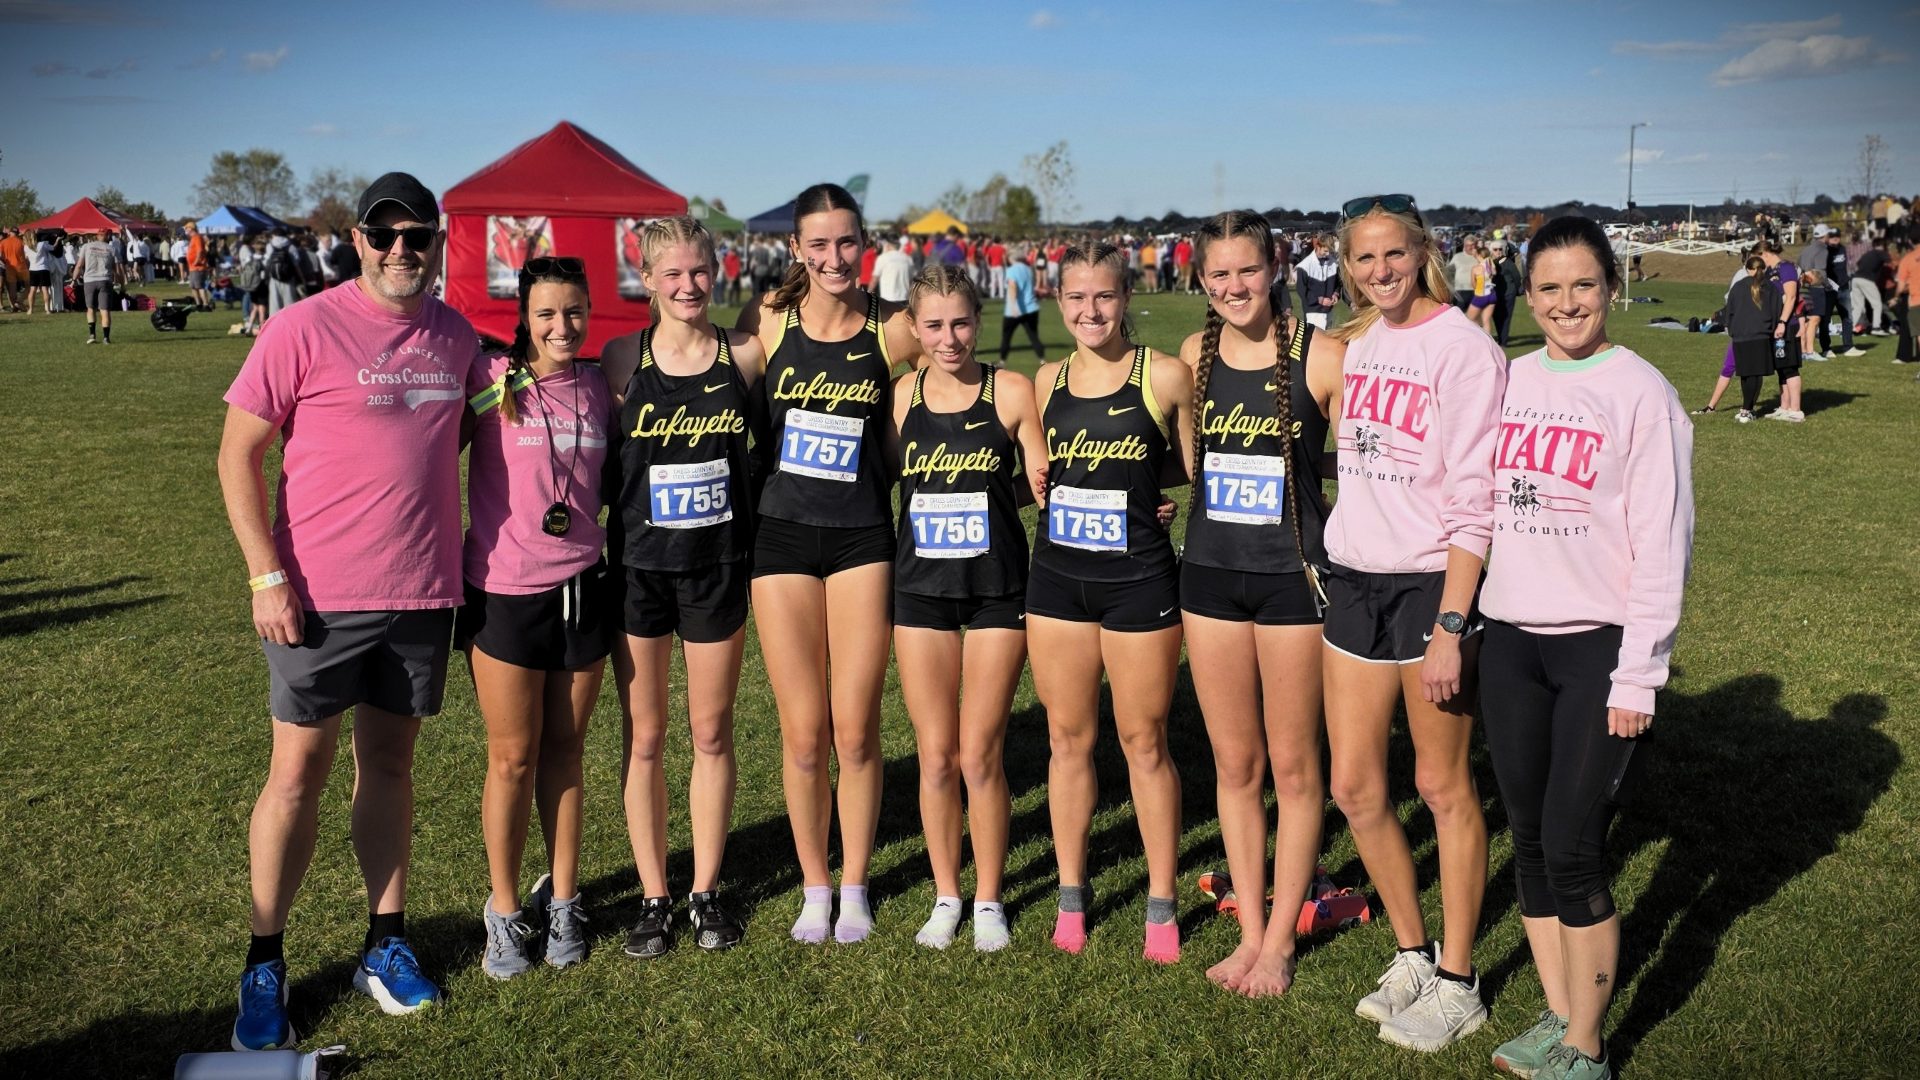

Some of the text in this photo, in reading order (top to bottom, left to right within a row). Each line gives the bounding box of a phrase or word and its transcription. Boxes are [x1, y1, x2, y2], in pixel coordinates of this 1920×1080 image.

[371, 350, 393, 369] LADY
[1356, 360, 1420, 377] aayette
[357, 367, 459, 388] Cross Country
[774, 366, 880, 412] Lafayette
[367, 394, 394, 406] 2025
[1341, 373, 1432, 442] TATE
[1505, 406, 1584, 422] Lafayette
[631, 403, 744, 447] Lafayette
[1202, 399, 1302, 447] Lafayete
[517, 436, 543, 446] 2025
[787, 431, 857, 467] 1757
[1047, 427, 1148, 472] Lafayette
[1497, 422, 1605, 491] TATE
[902, 441, 1000, 484] Lafayette
[1338, 465, 1359, 476] oss
[656, 482, 727, 516] 1755
[1207, 476, 1278, 510] 1754
[914, 515, 985, 544] 1756
[1052, 508, 1122, 542] 1753
[1513, 520, 1590, 537] Country
